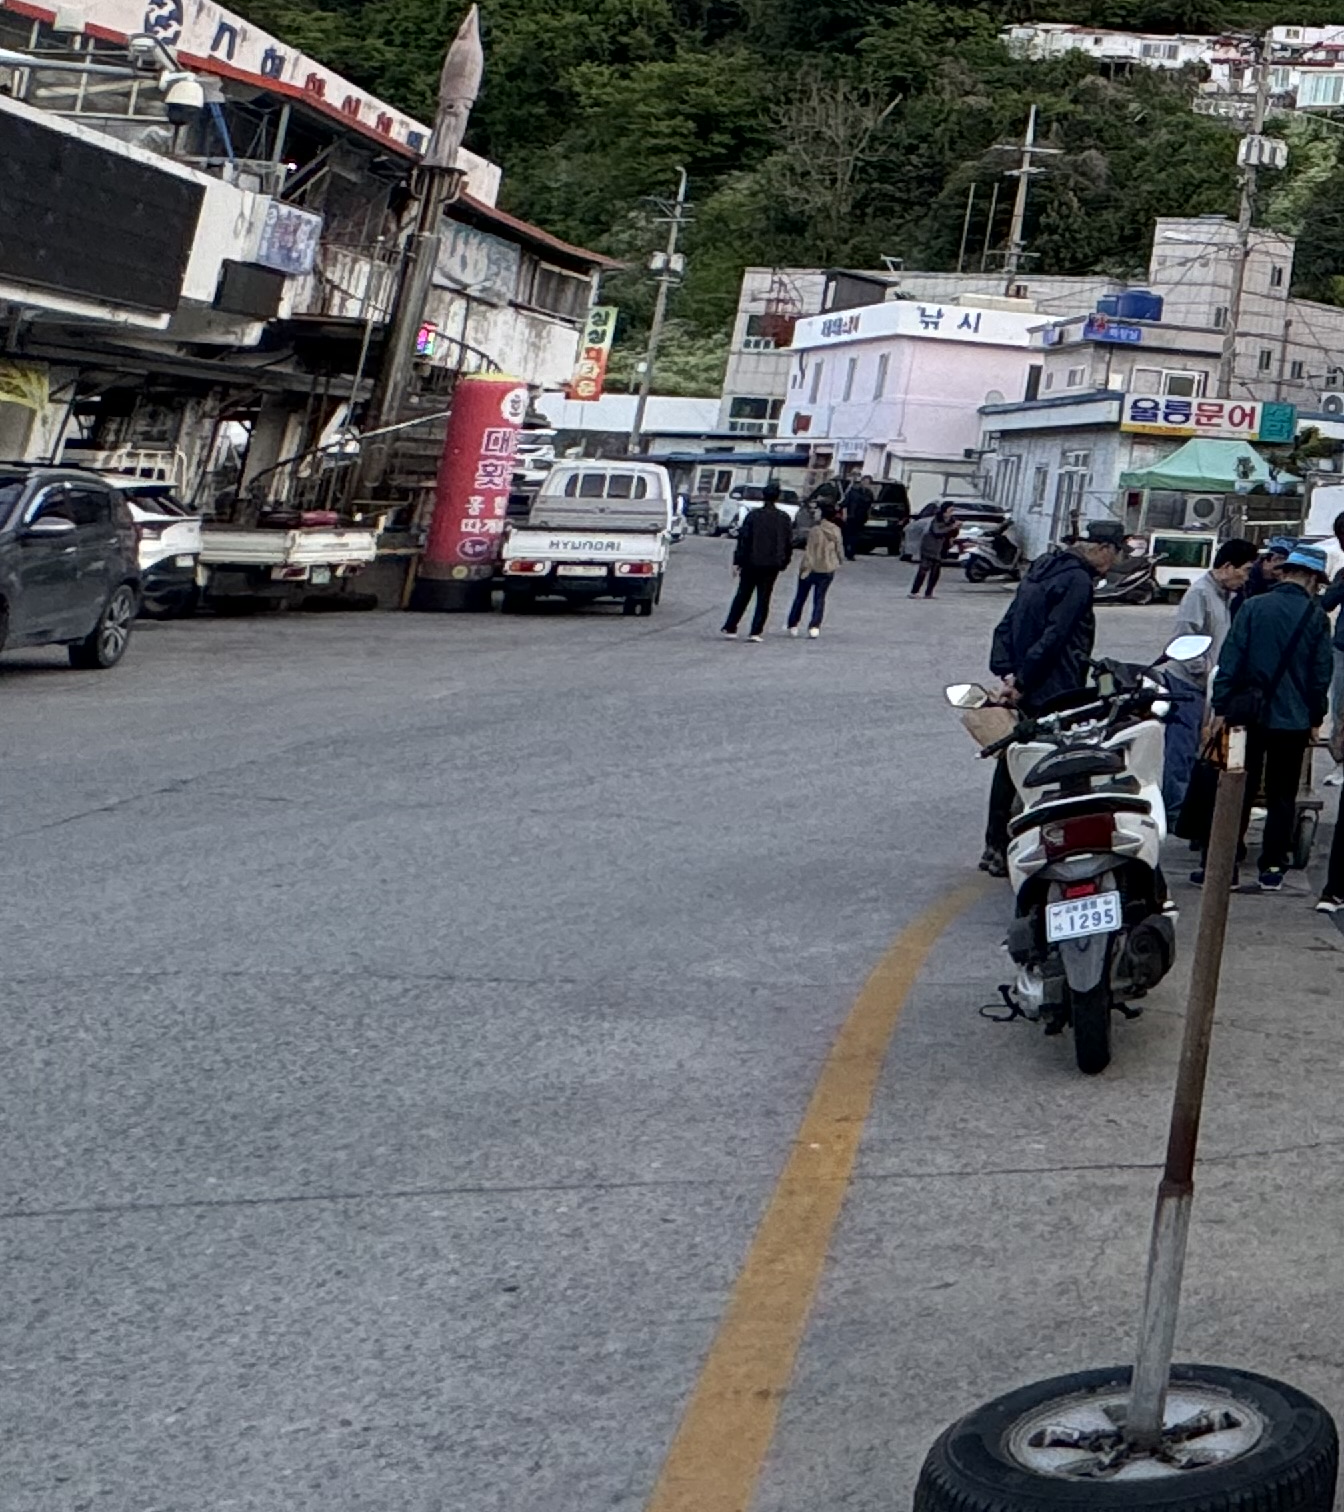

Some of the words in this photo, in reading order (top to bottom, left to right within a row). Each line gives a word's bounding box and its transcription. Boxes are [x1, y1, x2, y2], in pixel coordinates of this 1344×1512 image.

[1130, 397, 1256, 429] 울릉문어
[549, 540, 621, 552] HYUNDAI
[1069, 909, 1113, 931] 1295
